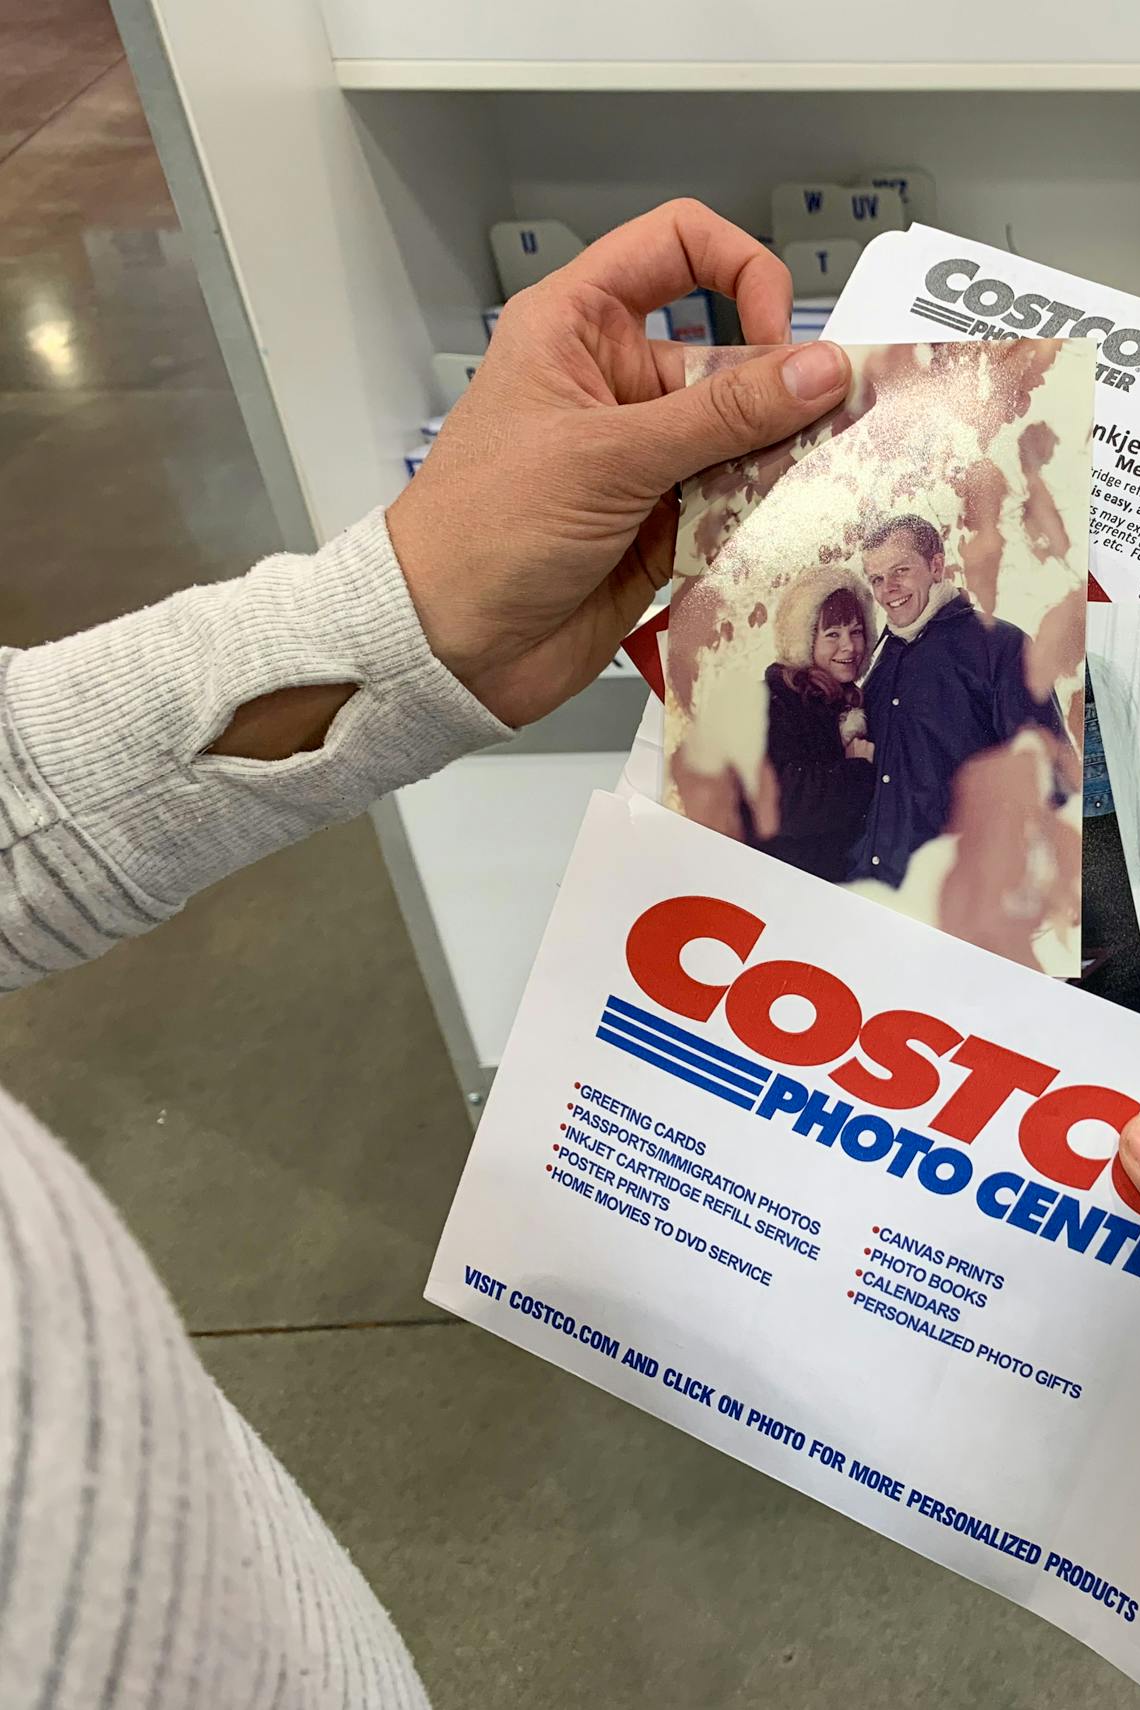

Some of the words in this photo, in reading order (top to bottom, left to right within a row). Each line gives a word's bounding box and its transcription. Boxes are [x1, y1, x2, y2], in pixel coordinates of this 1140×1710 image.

[803, 190, 823, 213] W
[852, 195, 878, 220] UV
[815, 251, 829, 272] T
[1091, 467, 1121, 487] ridge
[1091, 485, 1102, 497] is
[1104, 493, 1133, 513] easy,
[1099, 510, 1126, 528] may
[1103, 538, 1123, 553] etc.
[581, 1085, 652, 1130] GREETING
[654, 1122, 706, 1156] CARDS
[756, 1073, 974, 1195] PHOTO
[558, 1146, 615, 1186] POSTER
[616, 1176, 670, 1211] PRINTS
[565, 1125, 616, 1160] INKJET
[616, 1153, 702, 1203] CARTRIDGE
[702, 1193, 751, 1229] REFILL
[755, 1220, 821, 1261] SERVICE
[572, 1105, 757, 1205] PASSPORTS/IMMIGRATION
[757, 1195, 821, 1235] PHOTOS
[551, 1166, 594, 1199] HOME
[594, 1189, 651, 1226] MOVIES
[654, 1217, 674, 1236] TO
[675, 1228, 707, 1252] DVD
[708, 1245, 772, 1286] SERVICE
[870, 1248, 927, 1282] PHOTO
[928, 1273, 987, 1308] BOOKS
[879, 1228, 945, 1265] CANVAS
[945, 1255, 1004, 1290] PRINTS
[863, 1271, 960, 1322] CALENDARS
[853, 1291, 975, 1353] PERSONALIZED
[976, 1344, 1033, 1378] PHOTO
[1035, 1370, 1082, 1399] GIFTS
[465, 1265, 507, 1301] VISIT
[509, 1291, 620, 1359] COSTCO.COM
[621, 1348, 659, 1378] AND
[663, 1368, 716, 1407] CLICK
[718, 1395, 744, 1421] ON
[746, 1408, 806, 1451] PHOTO
[808, 1440, 846, 1473] FOR
[848, 1460, 905, 1502] MORE
[906, 1489, 1042, 1565] PERSONALIZED
[1043, 1552, 1139, 1622] PRODUCTS
